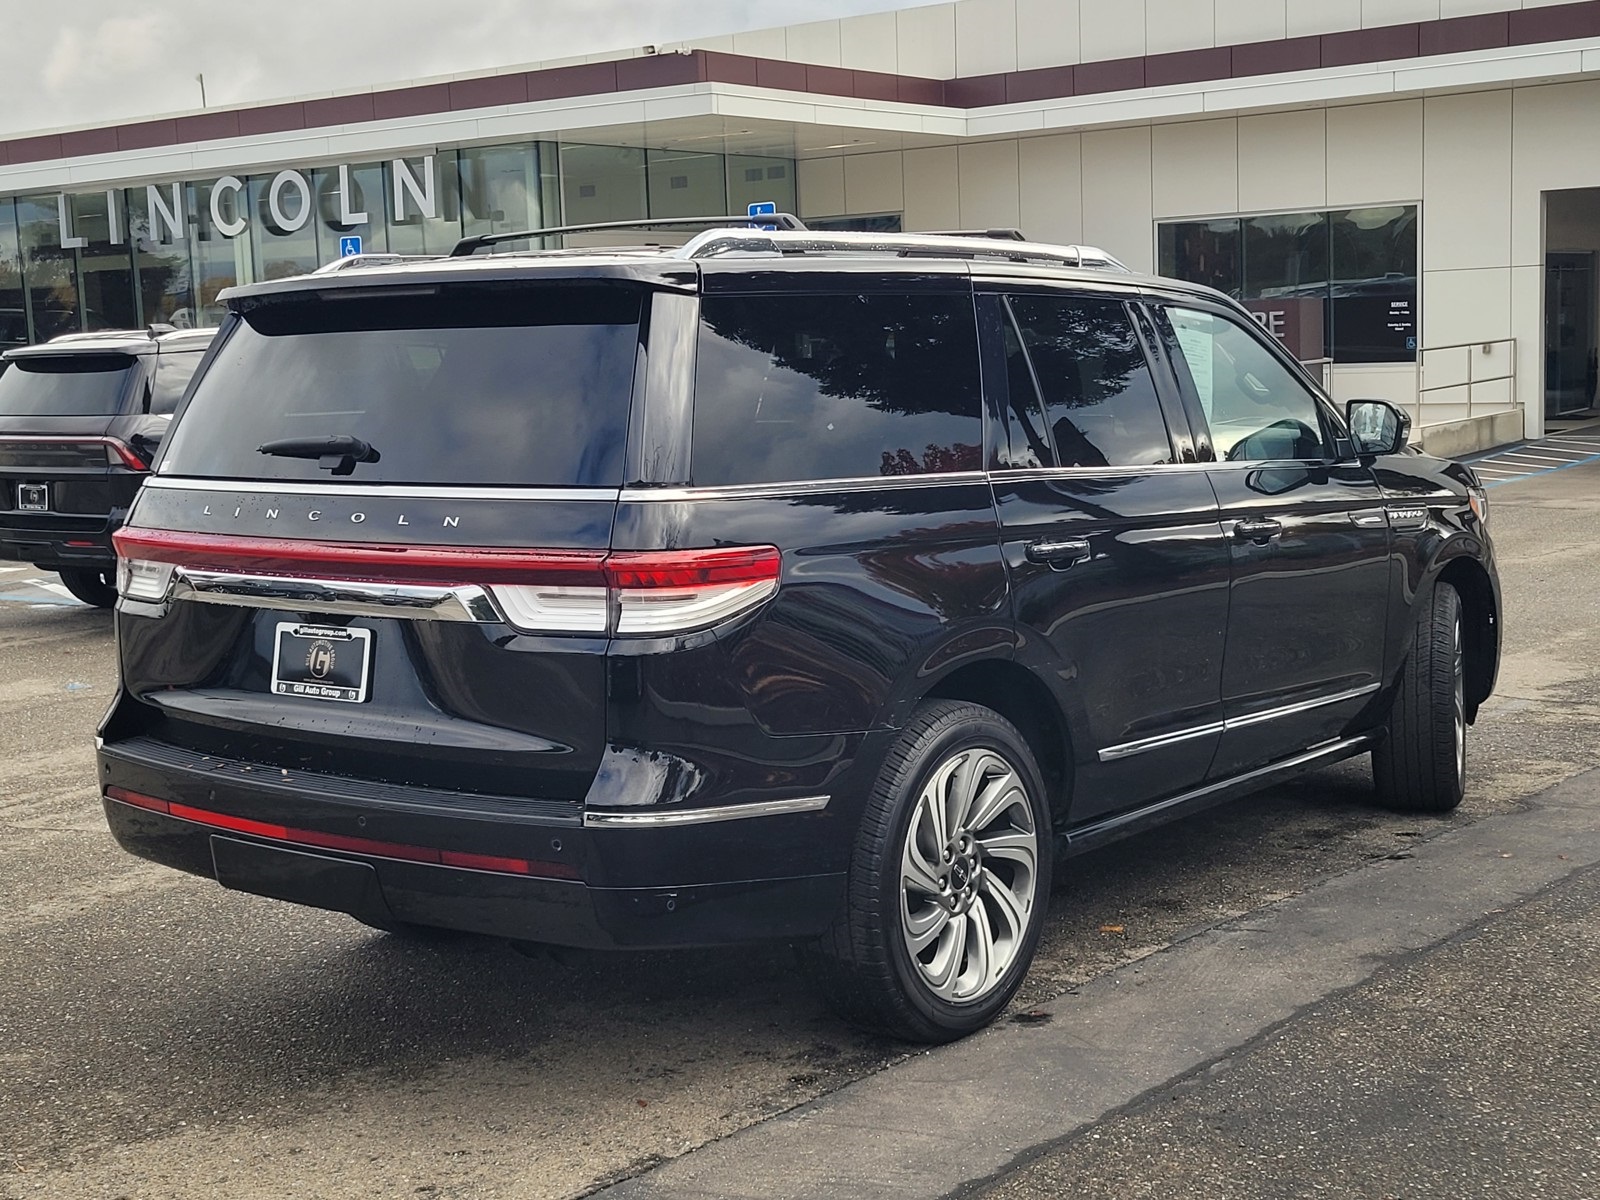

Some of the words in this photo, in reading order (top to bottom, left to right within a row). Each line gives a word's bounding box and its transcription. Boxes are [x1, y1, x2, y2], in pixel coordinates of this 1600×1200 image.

[57, 155, 437, 249] LINCOLN
[203, 505, 460, 528] LINCOLN
[293, 684, 305, 693] Gill
[305, 685, 319, 694] Auto
[320, 687, 341, 698] Group
